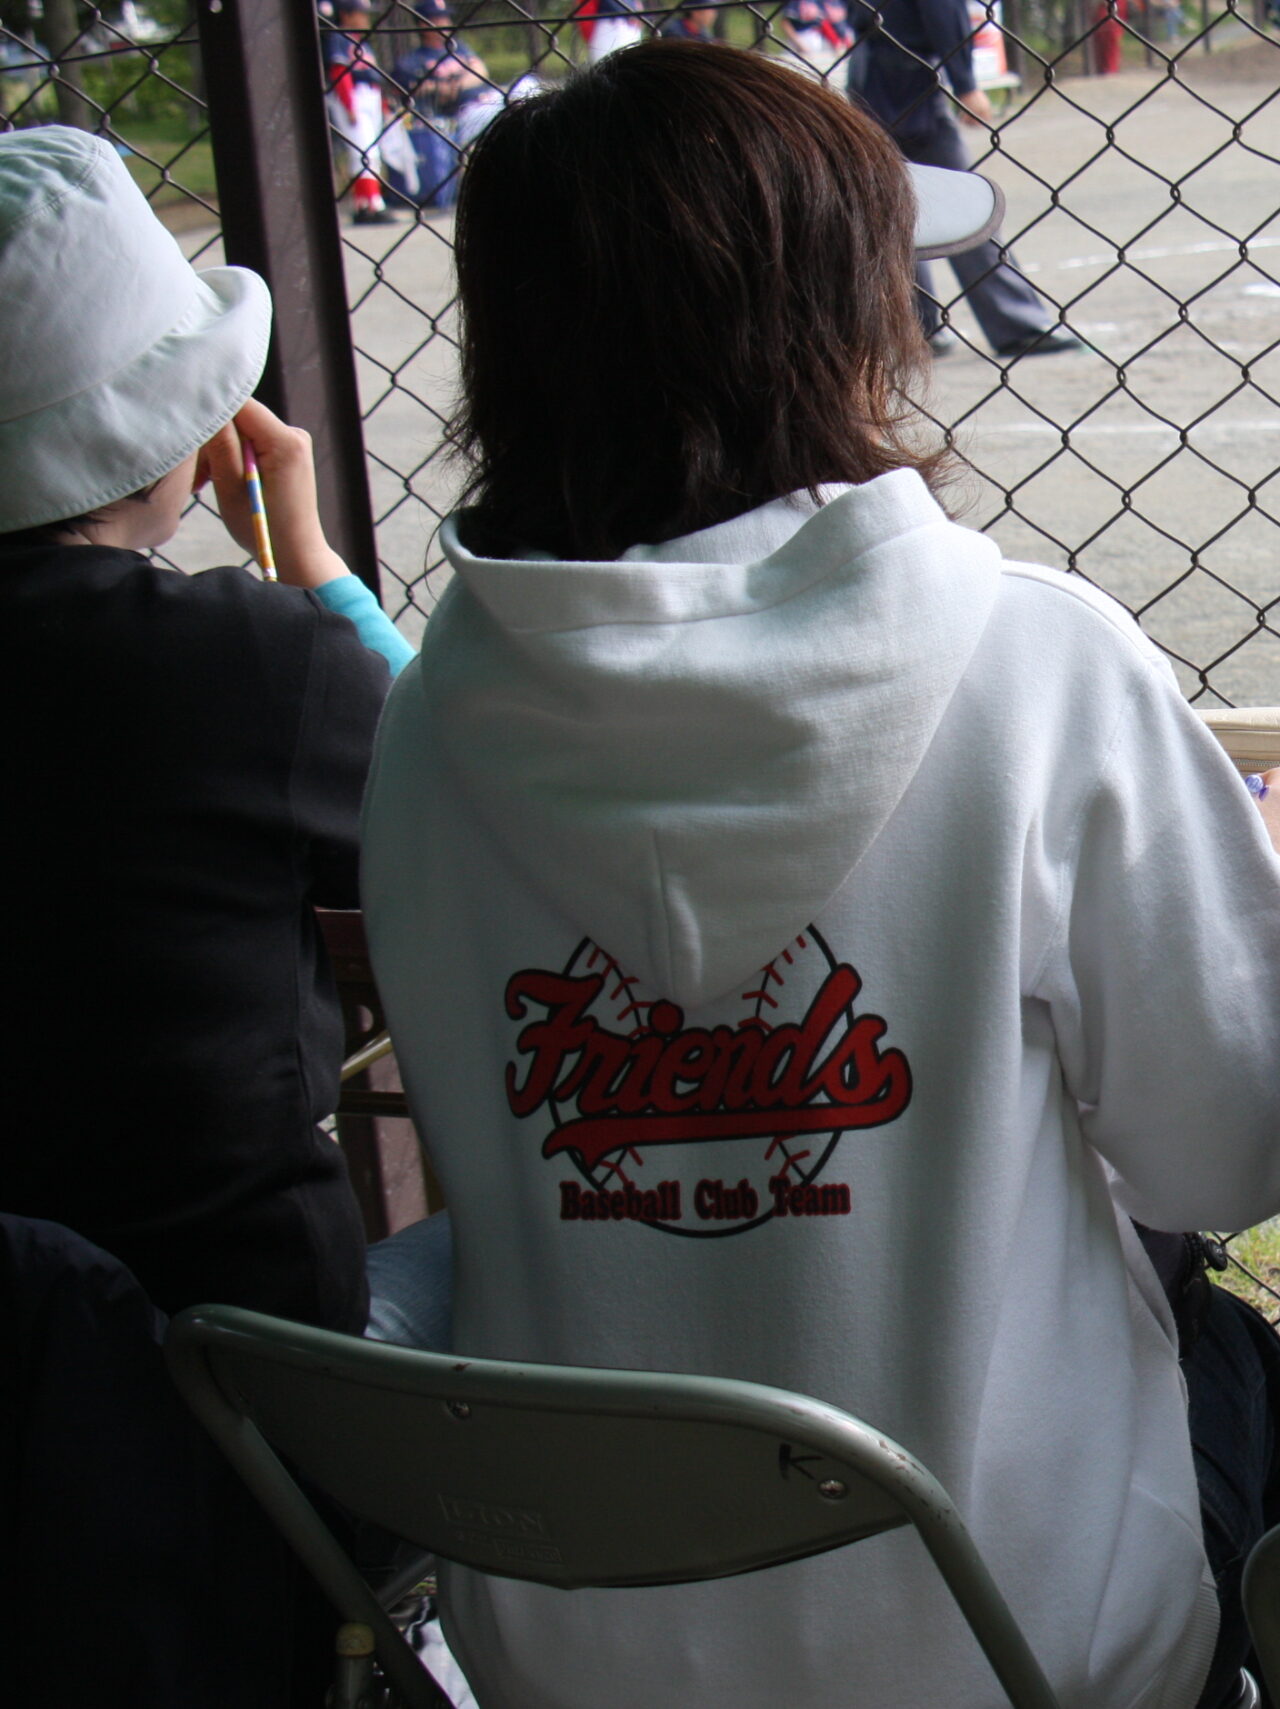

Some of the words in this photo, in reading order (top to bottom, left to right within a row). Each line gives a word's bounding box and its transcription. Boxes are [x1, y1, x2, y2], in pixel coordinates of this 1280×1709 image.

[504, 963, 913, 1170] Friends
[560, 1181, 682, 1220] Baseball
[694, 1179, 758, 1219] Club
[769, 1176, 850, 1216] Team
